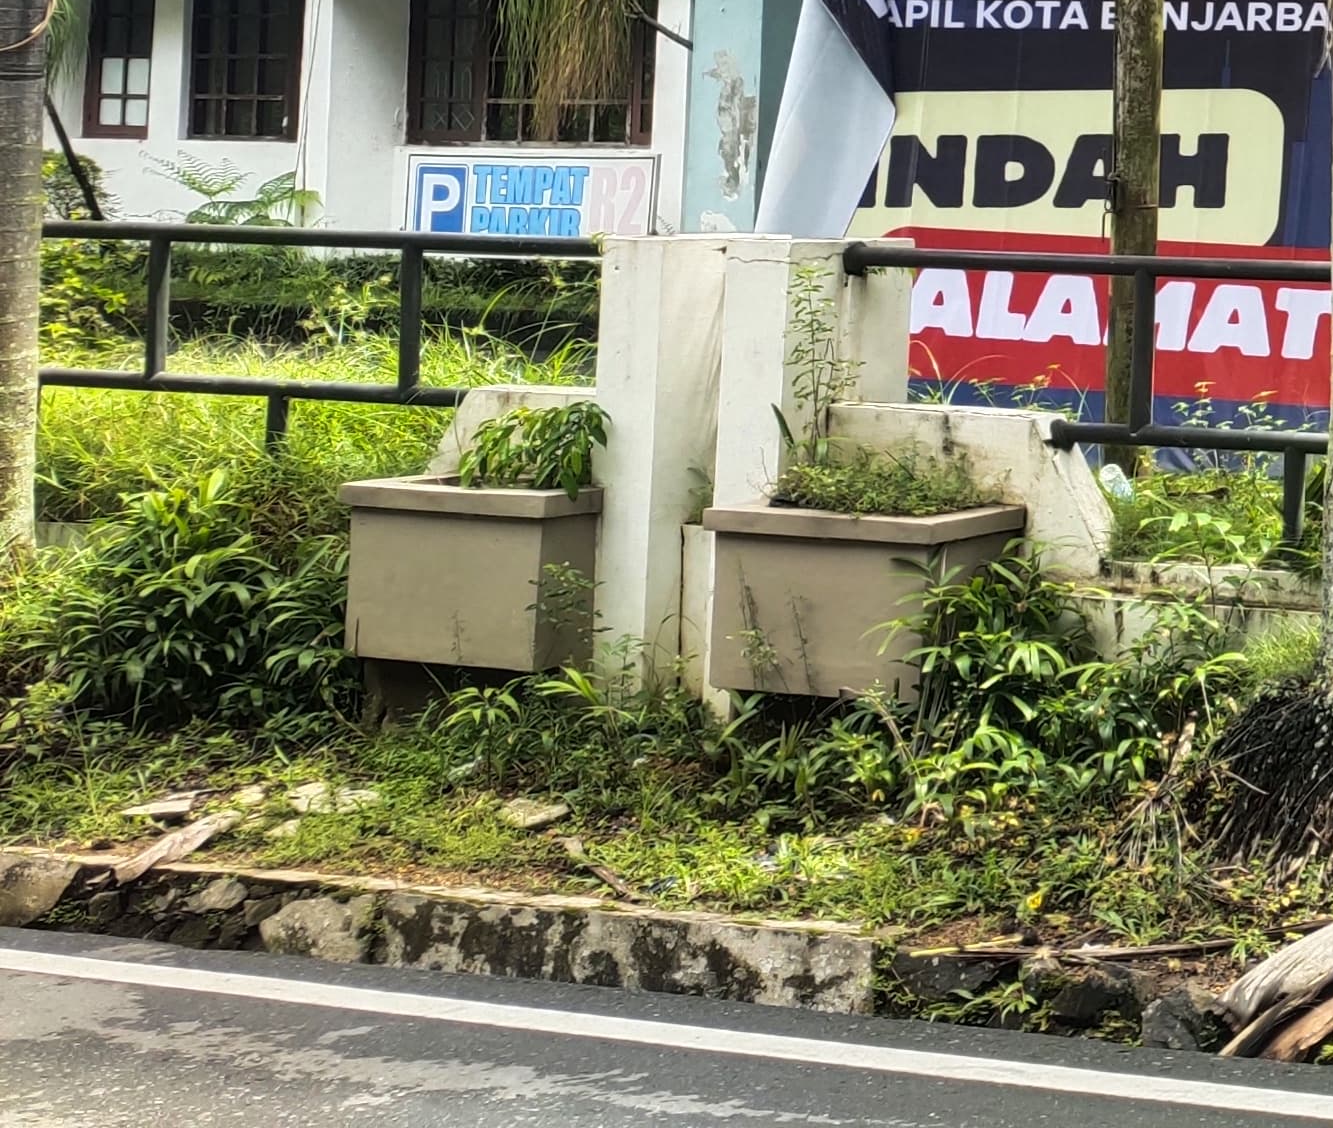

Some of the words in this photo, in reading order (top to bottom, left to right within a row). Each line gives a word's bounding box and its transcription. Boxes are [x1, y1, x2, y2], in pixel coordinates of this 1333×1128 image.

[975, 0, 1090, 30] KOTA
[1100, 1, 1333, 32] BNJARBA
[421, 173, 461, 233] P
[473, 164, 590, 206] TEMPAT
[588, 166, 647, 236] R2
